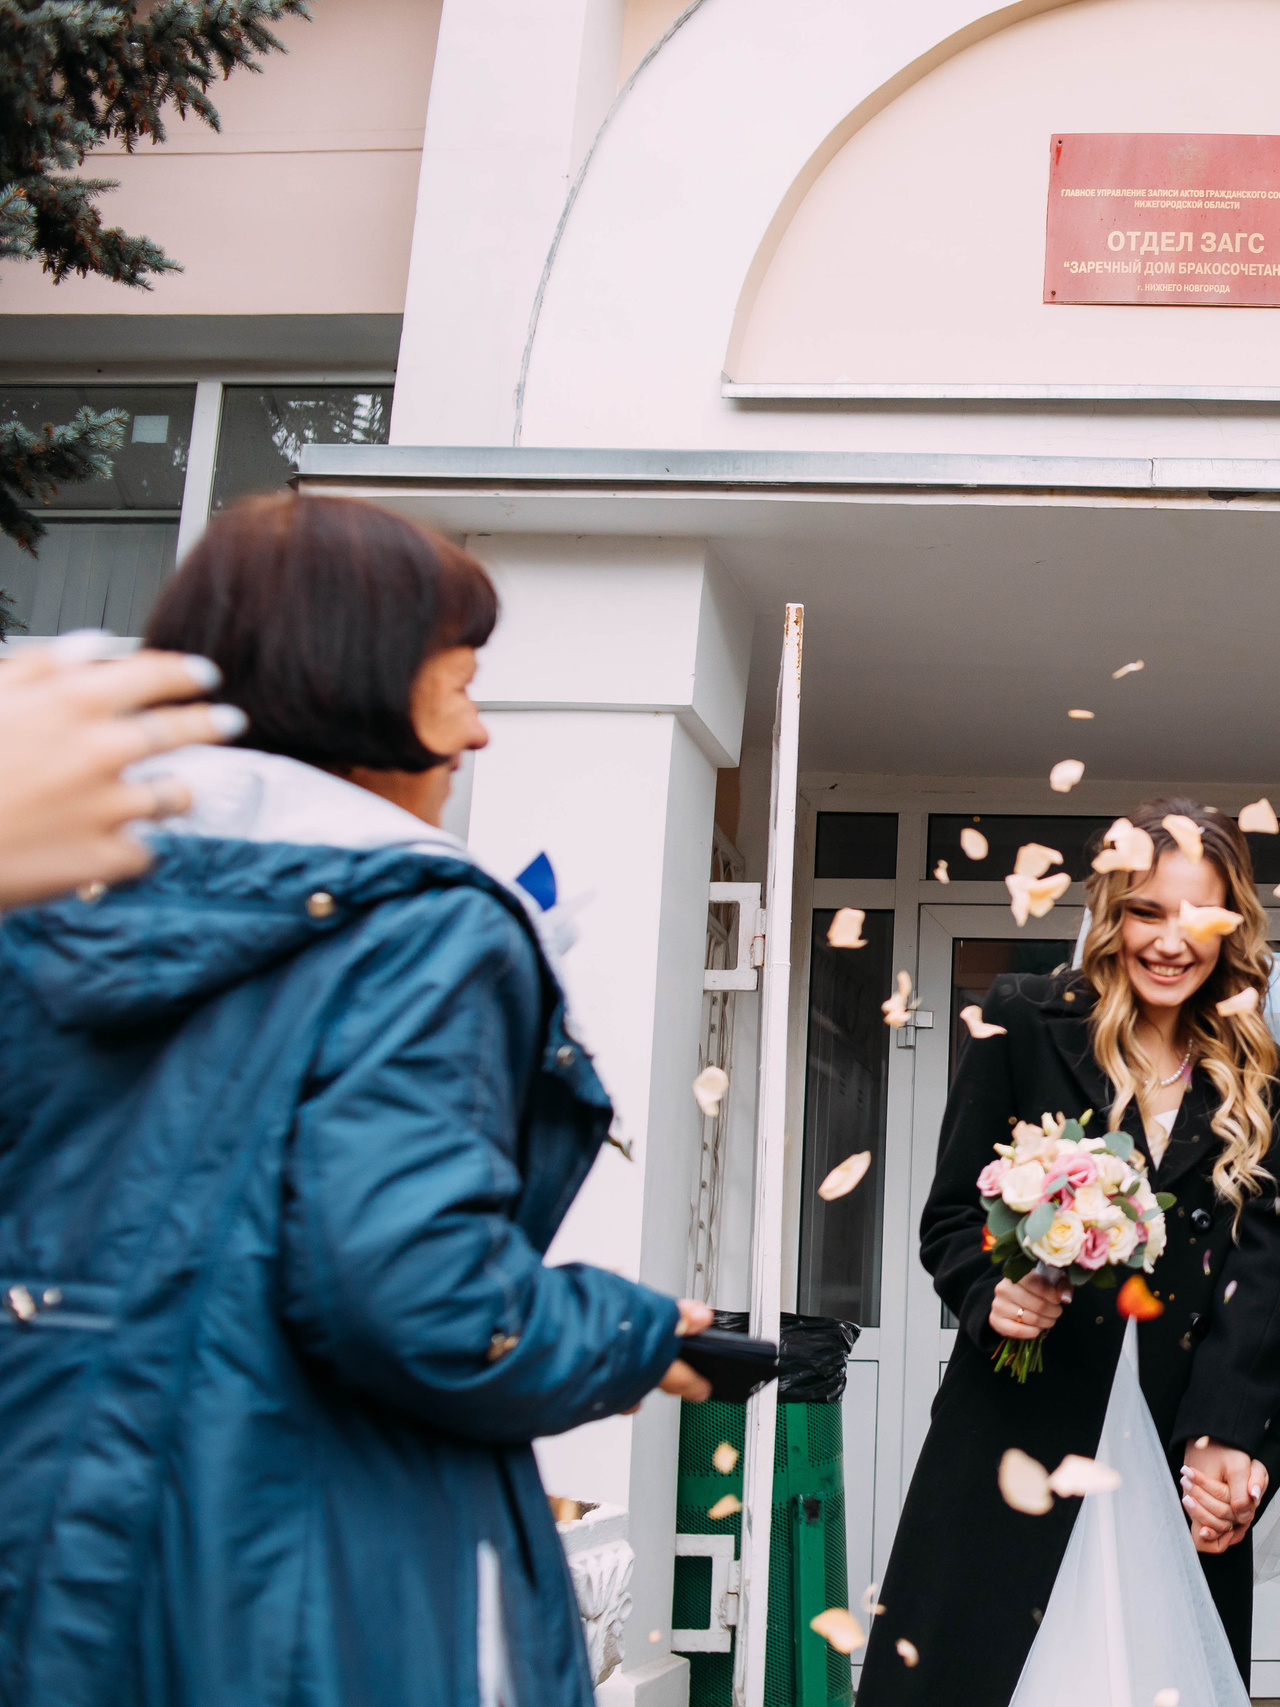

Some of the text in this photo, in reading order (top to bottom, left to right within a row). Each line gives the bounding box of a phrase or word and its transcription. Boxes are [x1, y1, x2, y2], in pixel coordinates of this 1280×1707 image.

[1061, 188, 1096, 197] ГЛАВНОЕ
[1097, 189, 1147, 198] УПРАВЛЕНИЕ
[1148, 190, 1179, 198] ЗАПИСИ
[1180, 190, 1205, 198] АКТОВ
[1206, 190, 1267, 200] ГРАЖДАНСКОГО
[1134, 200, 1240, 210] НИЖЕГОРОДСКОЙ ОБЛАСТИ
[1108, 230, 1265, 255] ОТДЕЛ ЗАГС
[1144, 262, 1175, 276] ДОМ
[1145, 284, 1182, 292] НИЖНЕГО
[1184, 284, 1230, 294] НОВГОРОДА
